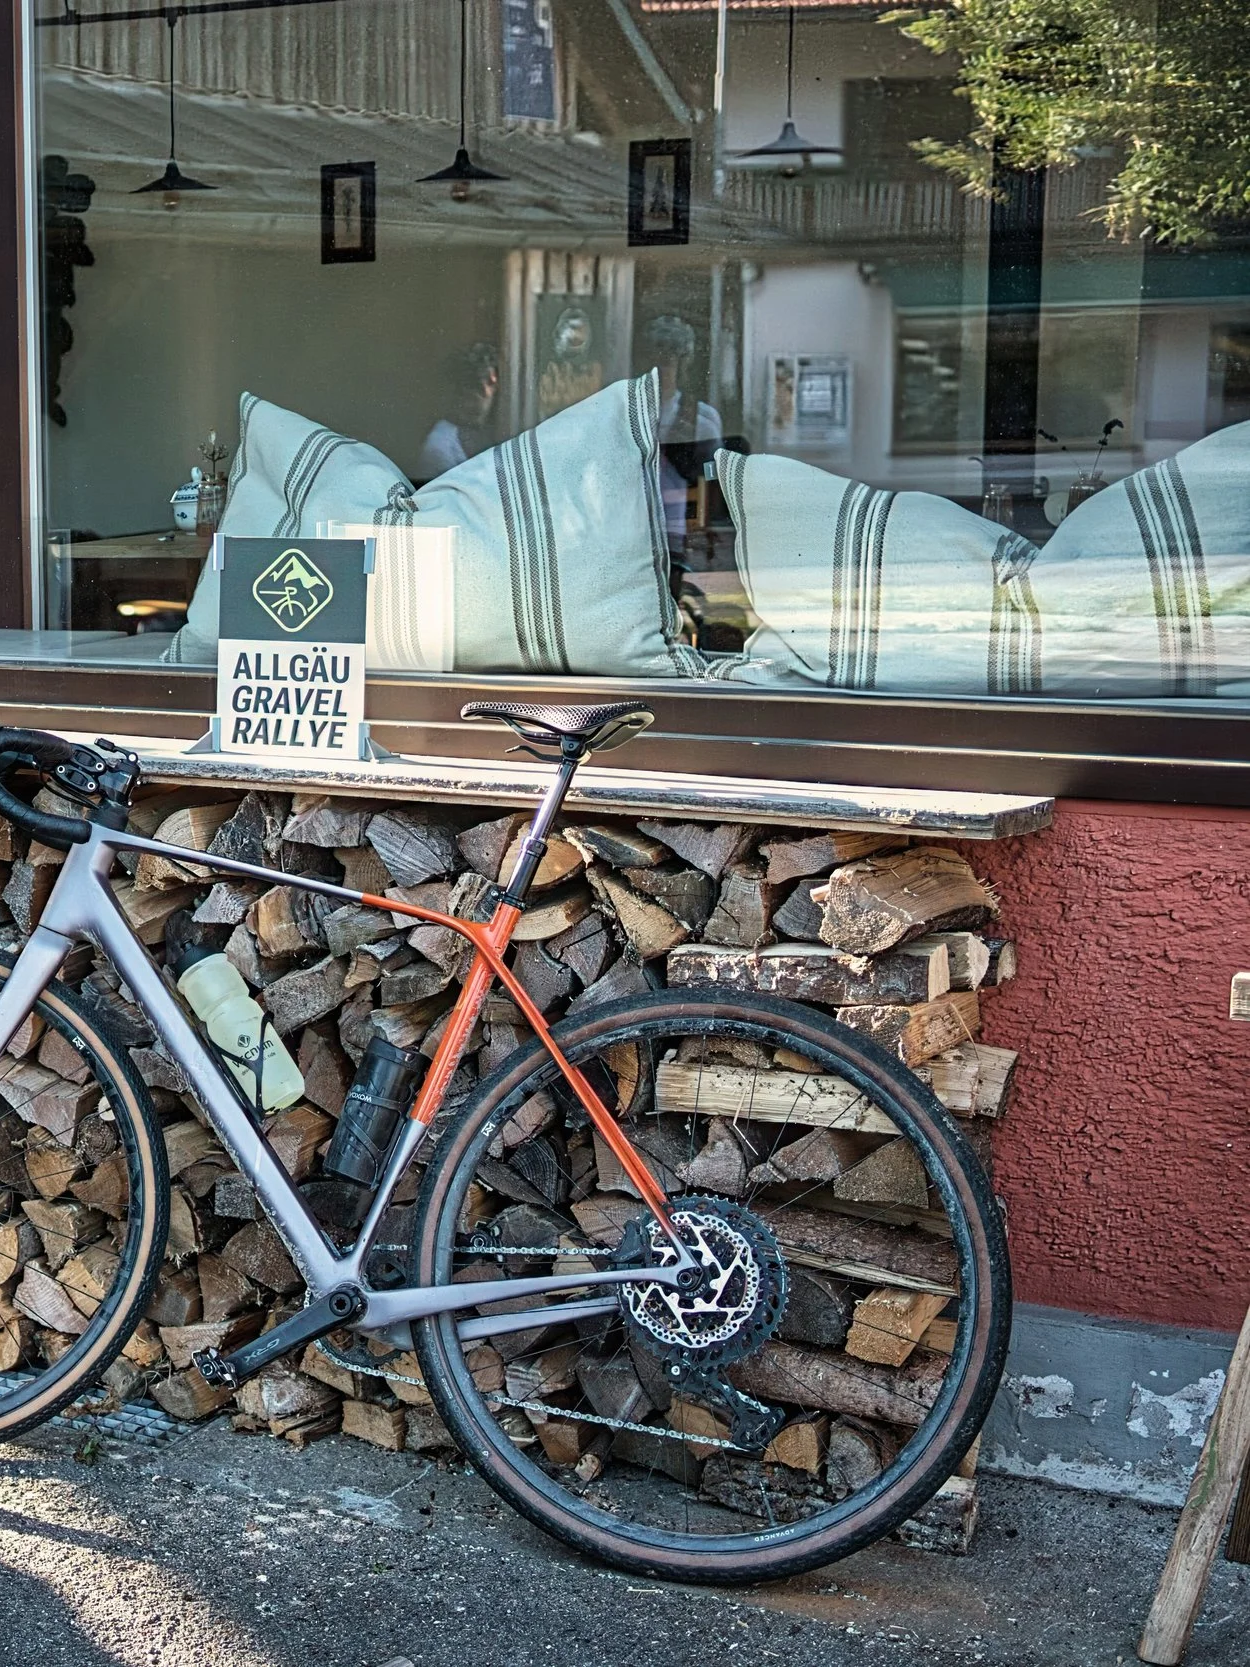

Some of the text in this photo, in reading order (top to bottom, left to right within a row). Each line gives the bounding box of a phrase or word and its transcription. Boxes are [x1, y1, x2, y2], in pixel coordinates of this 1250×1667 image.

[233, 647, 350, 683] ALLGÄU
[231, 686, 347, 717] GRAVEL
[231, 717, 348, 748] RALLYE
[244, 1338, 280, 1363] GRX
[754, 1529, 795, 1542] ADVANCED
